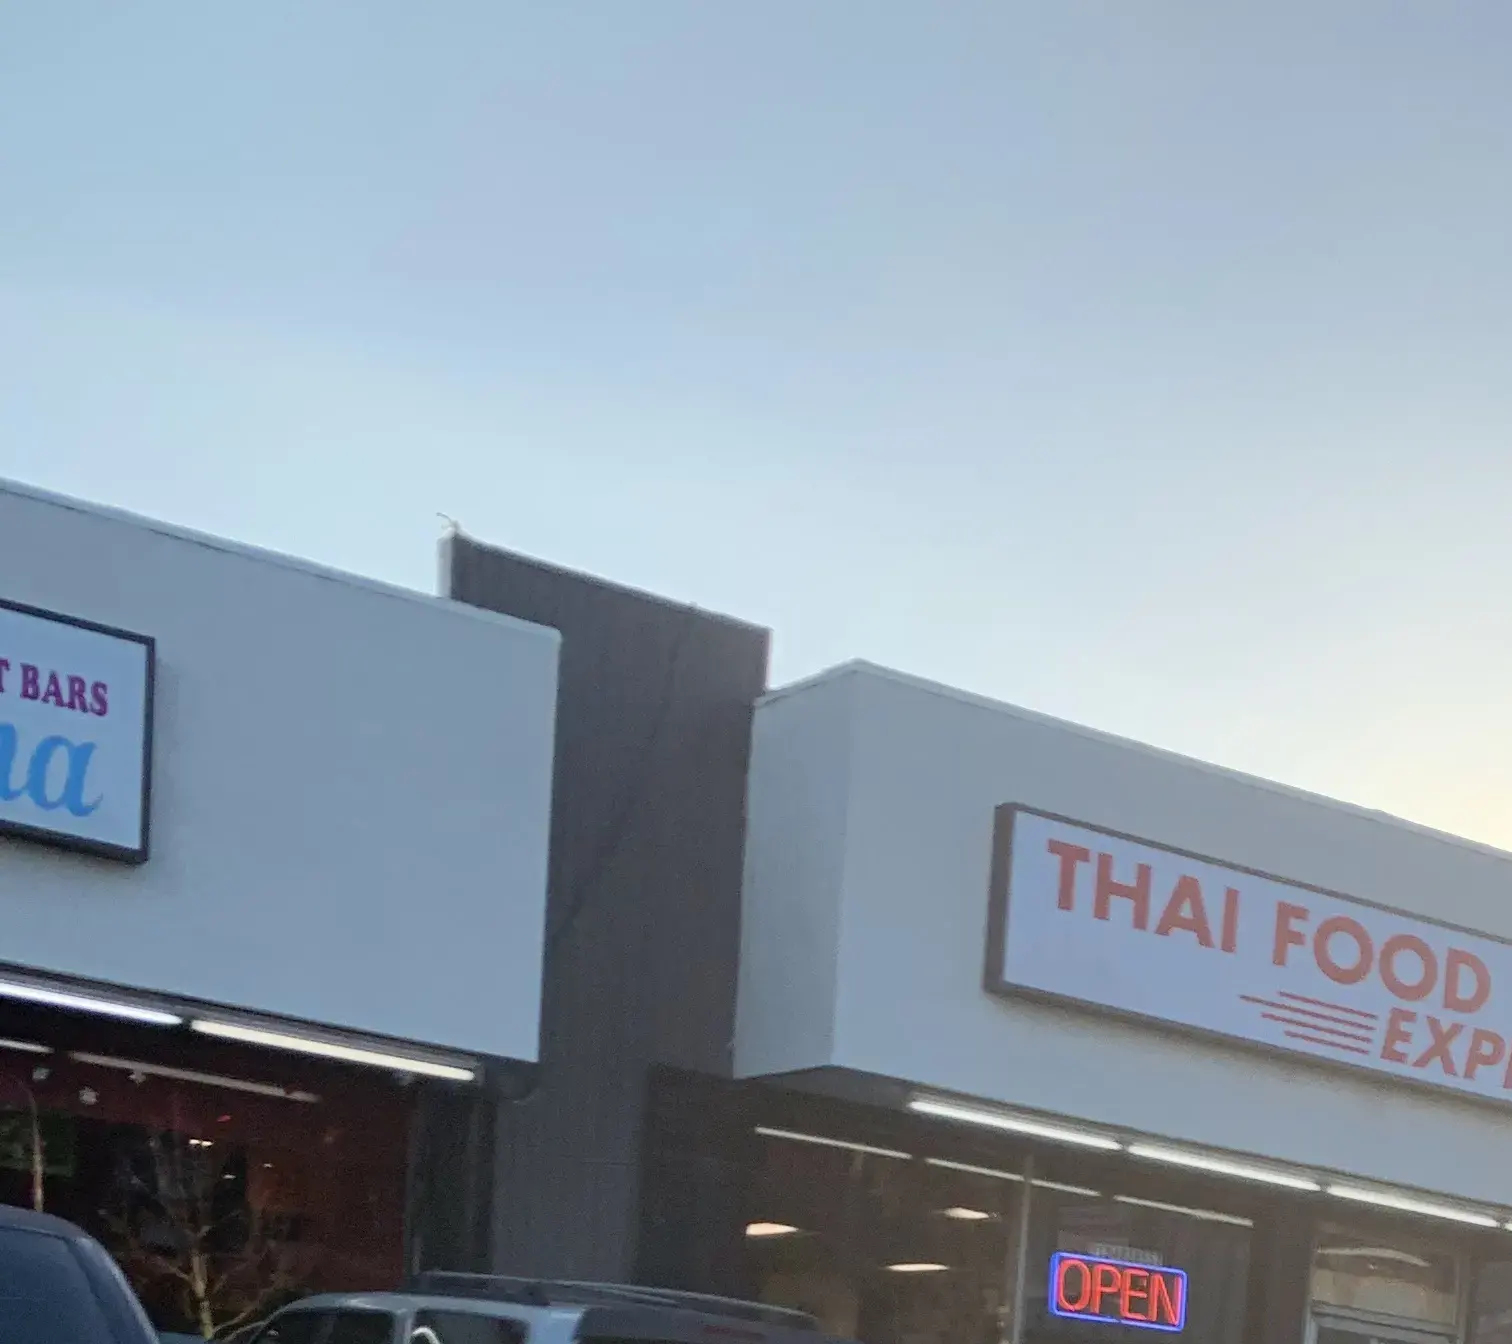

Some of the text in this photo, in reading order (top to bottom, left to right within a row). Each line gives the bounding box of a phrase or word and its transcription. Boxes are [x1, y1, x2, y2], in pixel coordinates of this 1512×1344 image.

[20, 662, 109, 718] BARS
[1047, 837, 1492, 1015] THAI FOOD
[1057, 1258, 1183, 1327] OPEN
